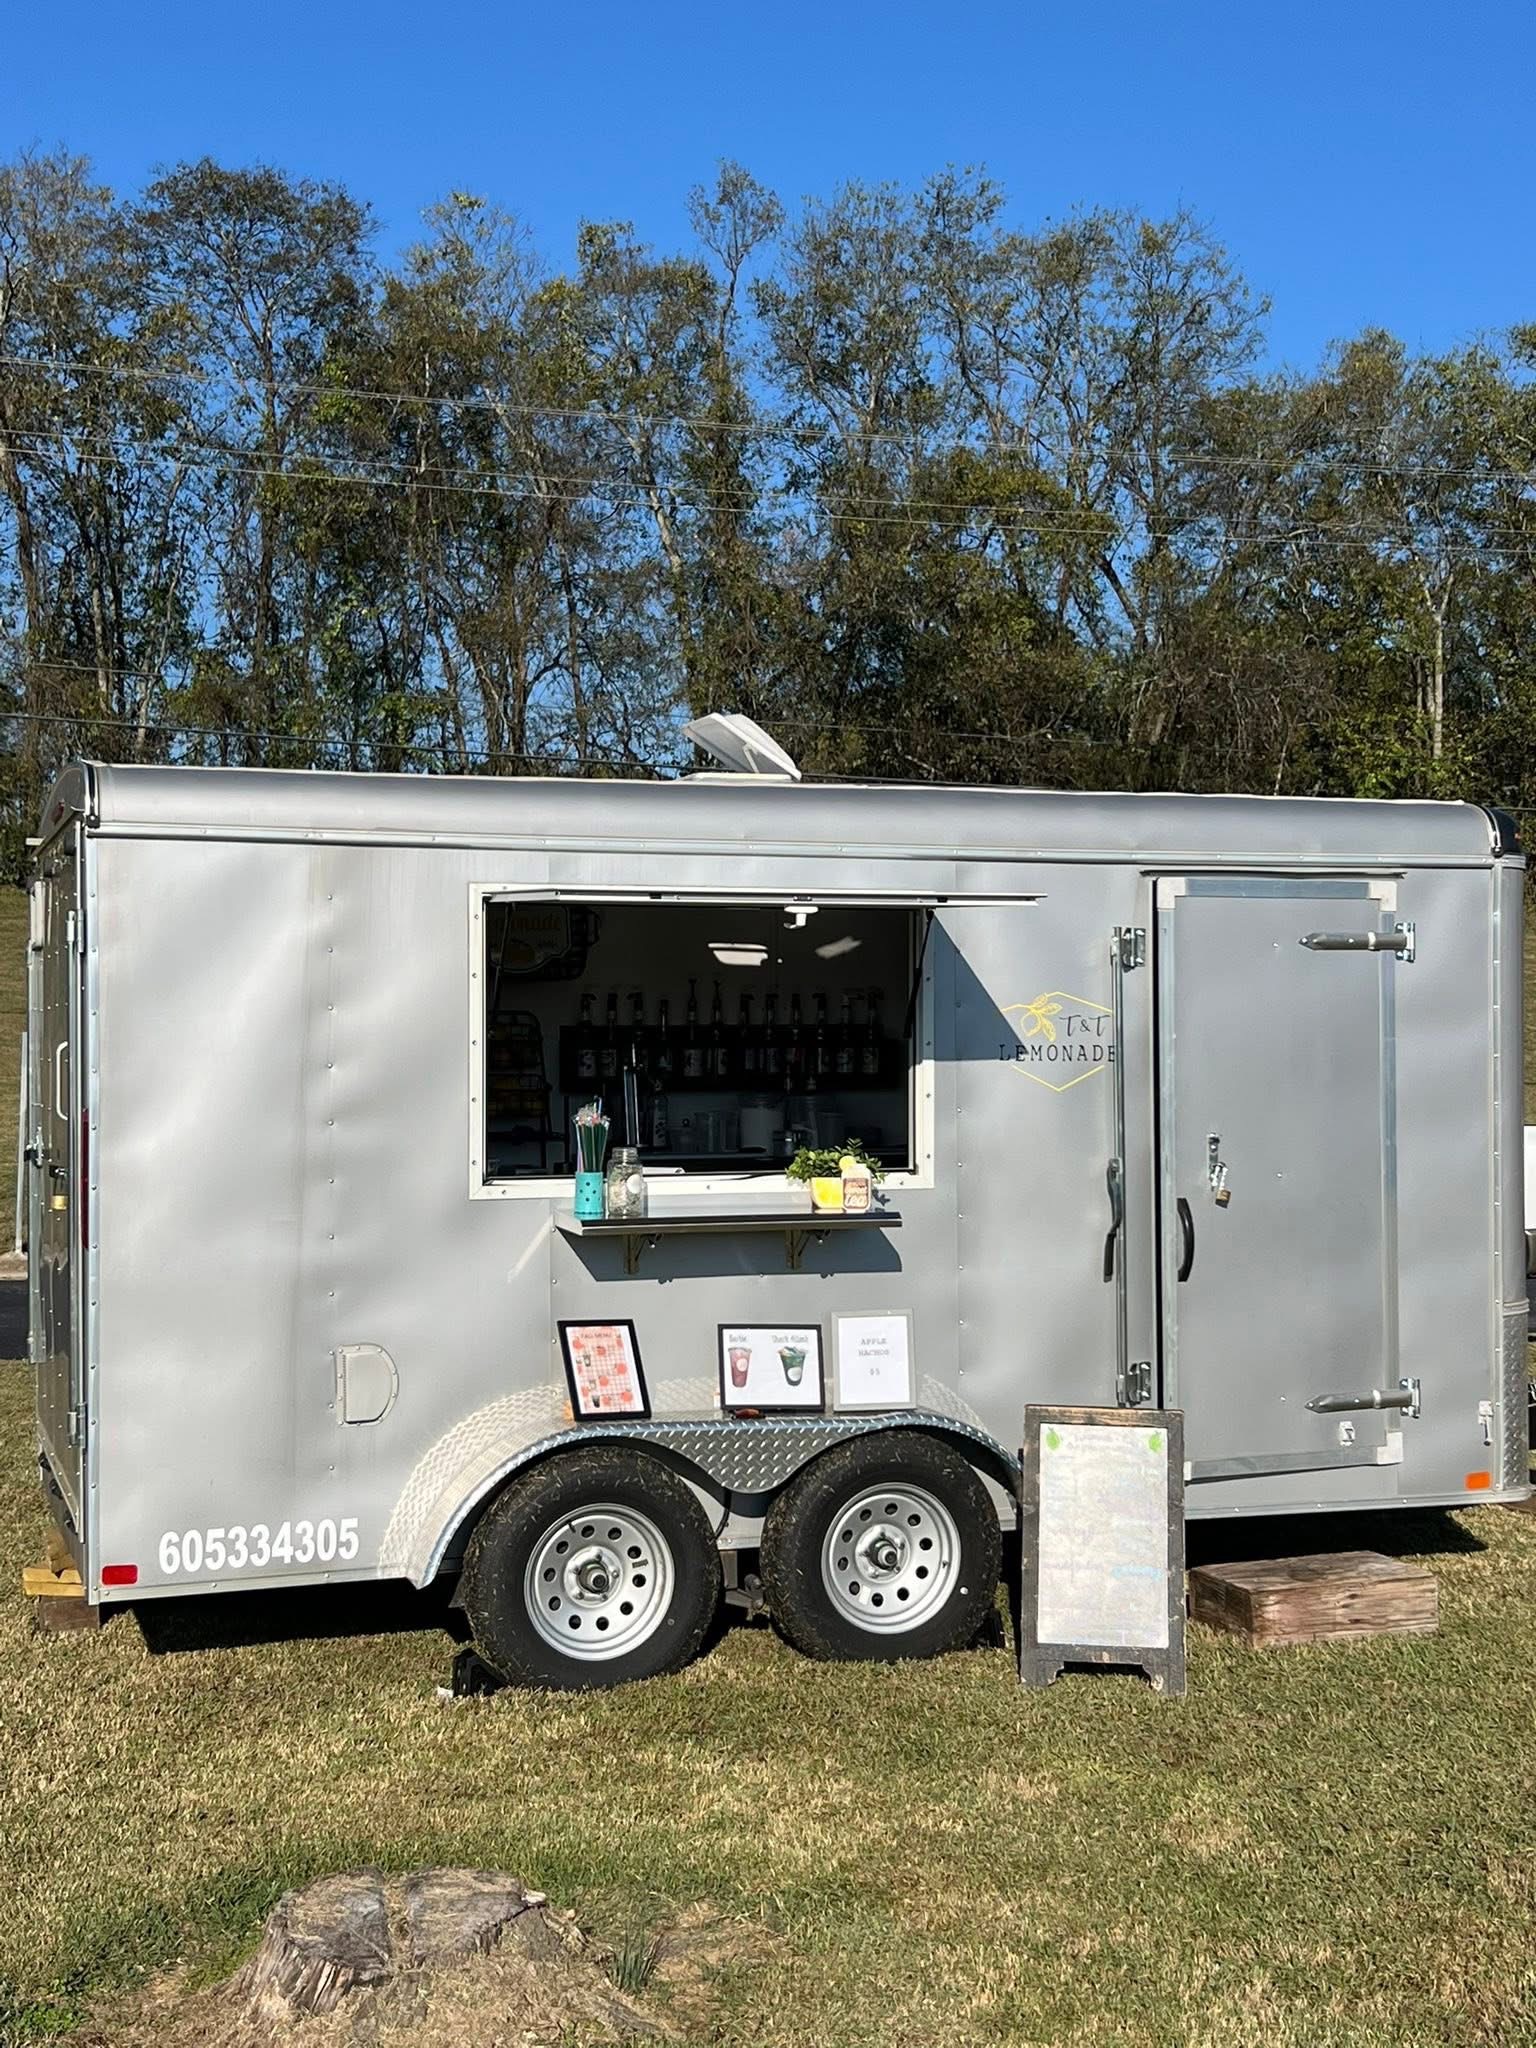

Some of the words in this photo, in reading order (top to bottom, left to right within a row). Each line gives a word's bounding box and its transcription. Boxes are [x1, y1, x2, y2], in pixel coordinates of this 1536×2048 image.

[1059, 1014, 1111, 1037] T&T
[999, 1044, 1116, 1062] LEMONADE
[158, 1517, 360, 1575] 605334305
